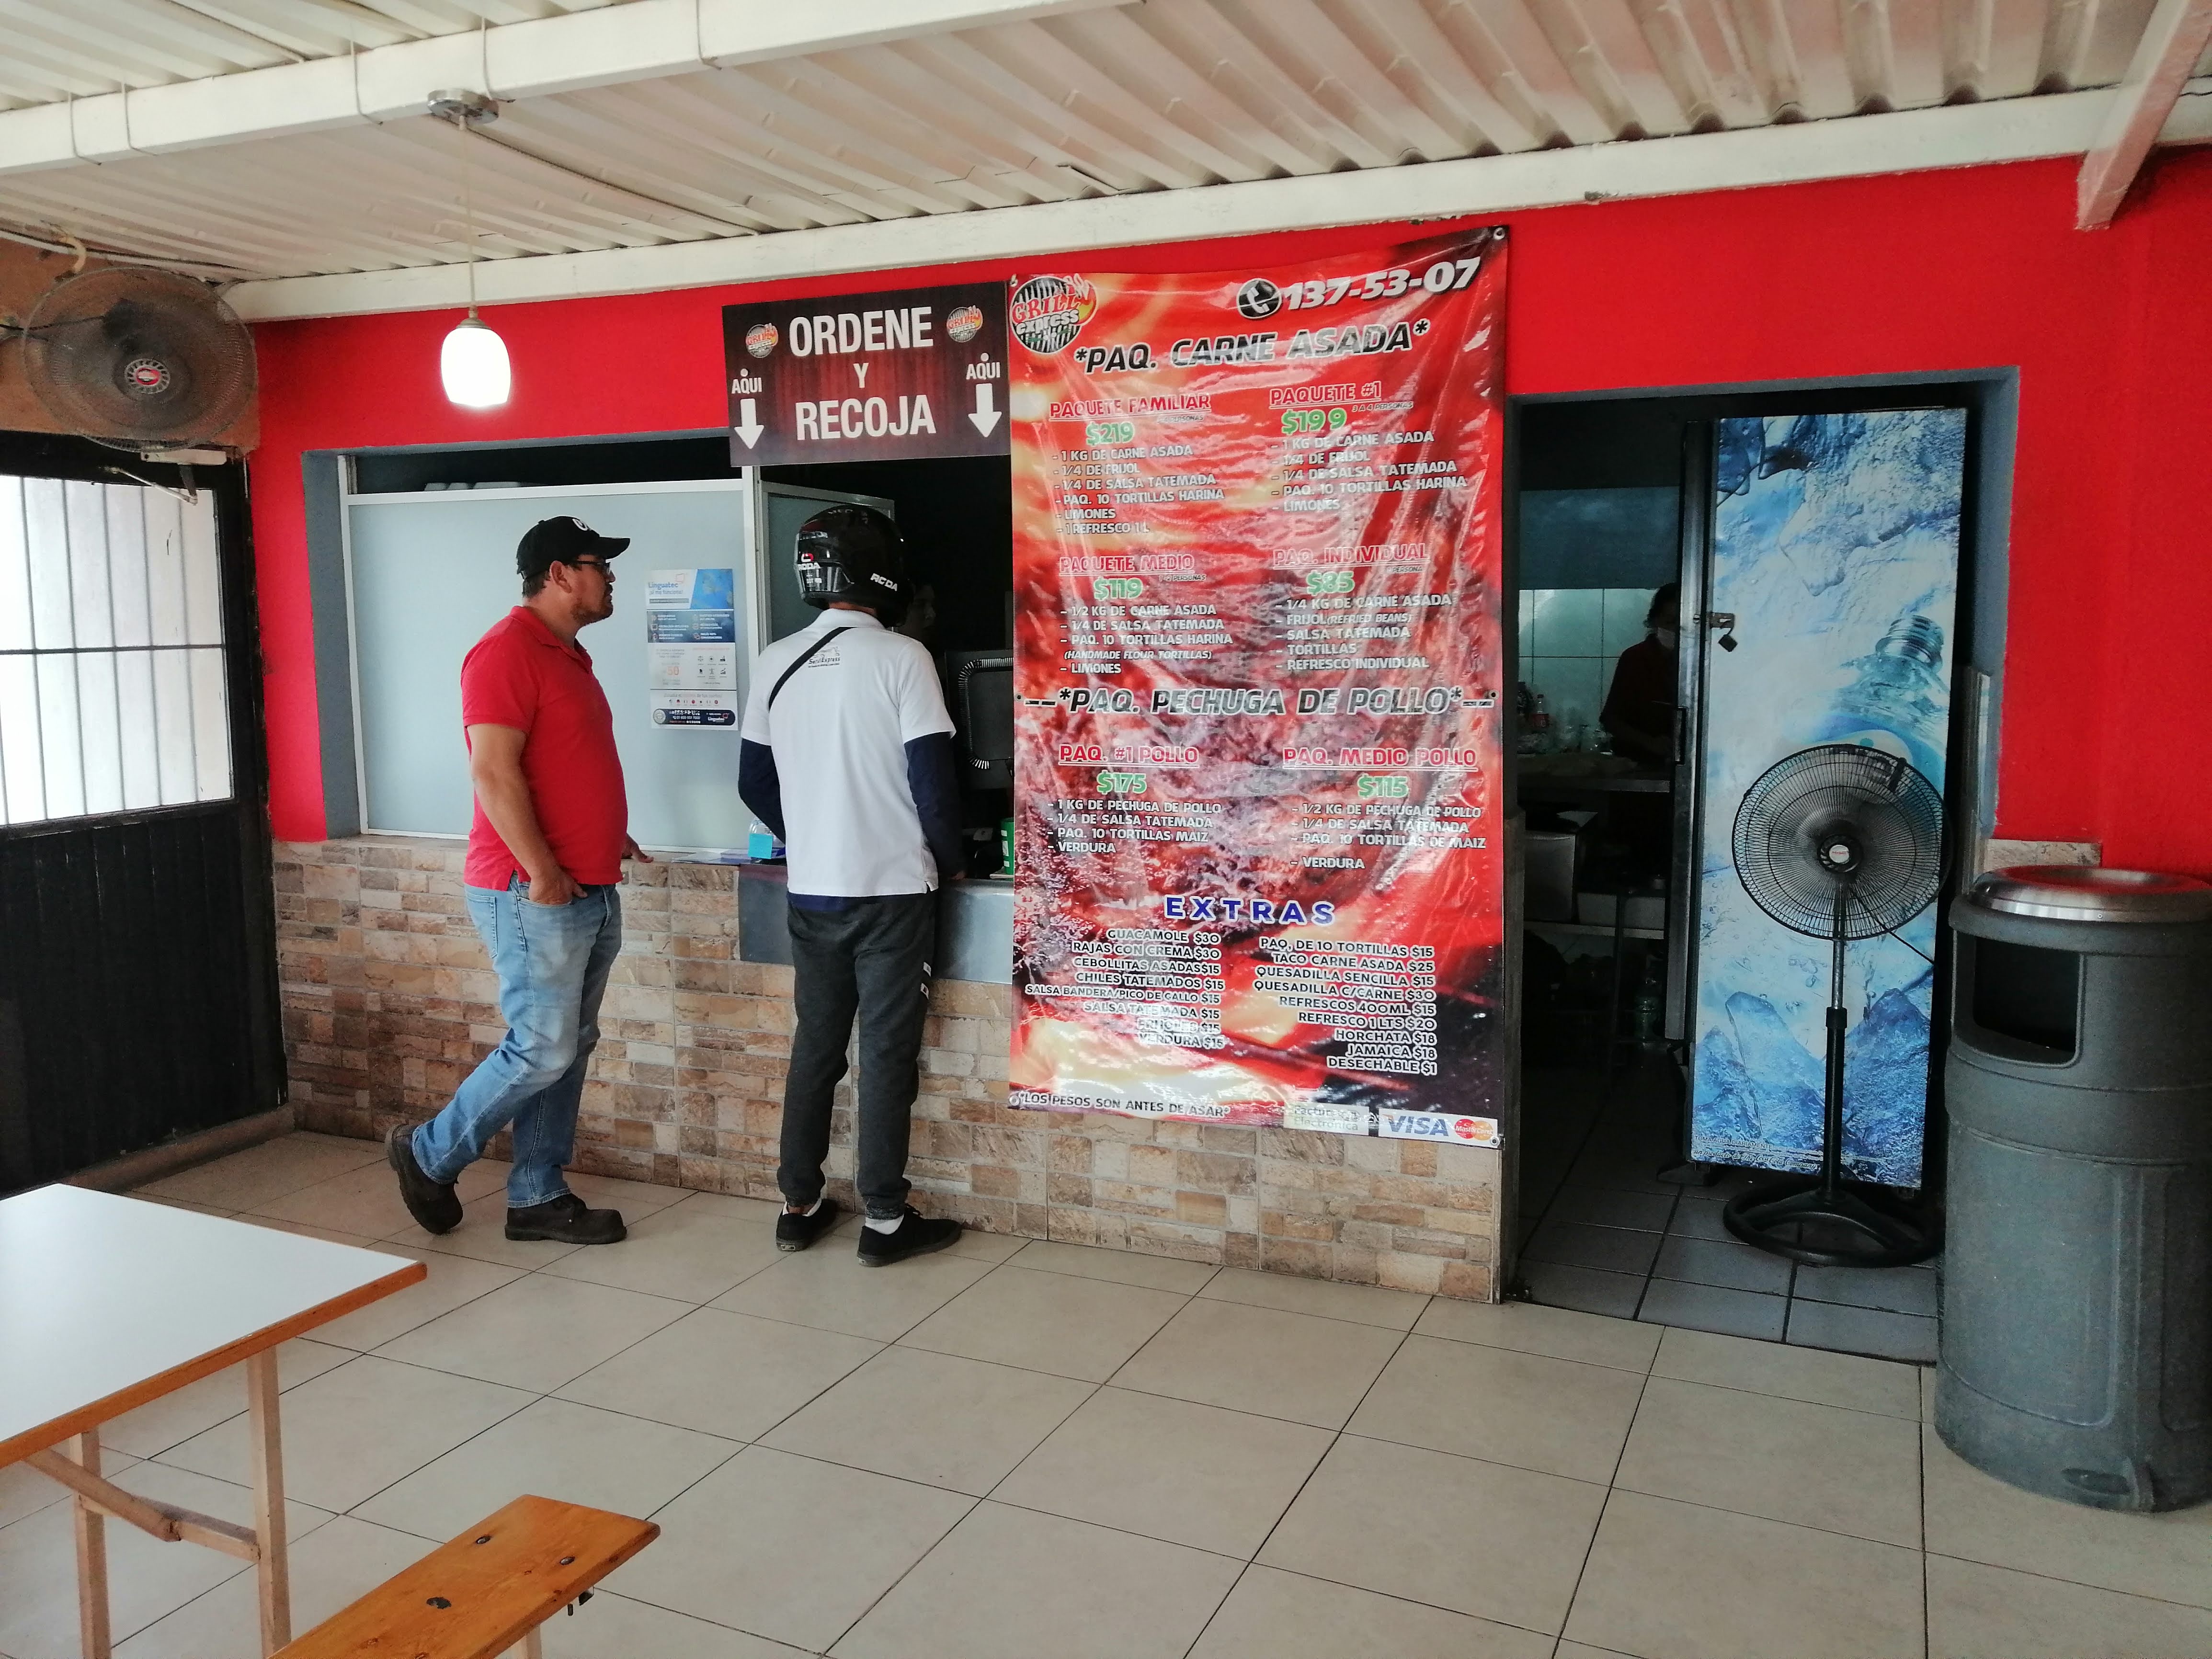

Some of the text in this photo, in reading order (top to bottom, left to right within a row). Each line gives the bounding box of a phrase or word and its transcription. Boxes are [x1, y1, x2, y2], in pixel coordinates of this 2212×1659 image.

[1282, 257, 1481, 310] 137-53-07
[1012, 294, 1080, 323] GRILL
[1016, 309, 1079, 334] express
[789, 306, 934, 357] ORDENE
[1171, 332, 1277, 366] CARNE
[853, 363, 869, 388] Y
[966, 362, 1001, 380] AQUI
[731, 377, 762, 394] AQUI
[1269, 381, 1381, 406] PAQUETE #1
[1050, 393, 1211, 418] PAQUETE FAMILIAR
[1374, 401, 1414, 410] PERSONAS
[795, 394, 936, 441] RECOJA
[1086, 421, 1135, 446] $219
[1384, 431, 1434, 444] ASADA
[1110, 445, 1193, 459] CARNE ASADA
[1086, 464, 1101, 475] DE
[1380, 460, 1458, 477] TATEMADA
[1086, 474, 1216, 490] DE SALSA TATEMADA
[1341, 476, 1467, 494] TORTILLAS HARINA
[1063, 489, 1224, 505] PAQ. TORTILLAS HARINA
[1284, 499, 1340, 511] LIMONES
[1065, 508, 1116, 520] LIMONES
[1072, 522, 1131, 534] REFRESCO
[1324, 543, 1430, 563] INDIVIDUAL
[1059, 554, 1195, 572] PAQUETE MEDIO
[648, 582, 679, 590] Linguatec
[1093, 576, 1143, 602] $119
[1306, 570, 1355, 596] $85
[1174, 604, 1217, 615] ASADA
[1287, 594, 1452, 610] 1/4 ASADA
[1111, 619, 1224, 630] SALSA TATEMADA
[1337, 626, 1411, 639] TATEMADA
[1120, 634, 1233, 645] TORTILLAS HARINA
[1064, 650, 1212, 659] (HANDMADE TORTILLAS)
[1287, 643, 1357, 655] TORTILLAS
[1072, 663, 1122, 674] LIMONES
[1287, 657, 1430, 670] REFRESCO INDIVIDUAL
[1150, 688, 1286, 716] PECHUGA
[1296, 686, 1340, 715] DE
[1059, 745, 1199, 764] PAQ. POLLO
[1283, 748, 1476, 766] PAQ. MEDIO POLLO
[1096, 770, 1147, 795] $175
[1357, 773, 1409, 799] $115
[1067, 800, 1222, 814] KG DE PECHUGA DE POLLO
[1326, 804, 1421, 816] KG PECHUGA
[1058, 814, 1214, 829] 1/4 DE SALSA TATEMADA
[1349, 819, 1470, 833] SALSA TATEMADA
[1058, 829, 1209, 842] PAQ. TORTILLAS MAIZ
[1357, 834, 1486, 849] TORTILLAS MAIZ
[1058, 842, 1116, 853] VERDURA
[1302, 857, 1365, 869] VERDURA
[1164, 895, 1334, 926] EXTRAS
[1107, 929, 1221, 944] GUACAMOLE $30
[1072, 941, 1221, 959] RAJAS CON CREMA $30
[1296, 939, 1434, 957] DE TORTILLAS $15
[1073, 957, 1148, 970] CEBOLLITAS
[1273, 953, 1435, 972] TACO CARNE ASADA $25
[1075, 973, 1225, 990] CHILES TATEMADOS $15
[1256, 966, 1436, 987] QUESADILLA SENCILLA $15
[1025, 984, 1221, 1004] SALSA BANDERA/PICO DE GALLO $15
[1253, 980, 1437, 1001] QUESADILLA C/CARNE $30
[1083, 1001, 1220, 1020] SALSA TATEMADA $15
[1279, 996, 1436, 1015] REFRESCOS $15
[1298, 1011, 1437, 1031] REFRESCO $20
[1139, 1033, 1201, 1047] VERDURA
[1334, 1029, 1436, 1045] HORCHATA $18
[1346, 1044, 1437, 1059] JAMAICA $18
[1327, 1057, 1437, 1075] DESECHABLE $1
[1051, 1095, 1091, 1107] PESOS
[1095, 1099, 1121, 1109] SON
[1125, 1100, 1164, 1113] ANTES
[1168, 1103, 1185, 1114] DE
[1387, 1115, 1494, 1136] VISA MasterCard
